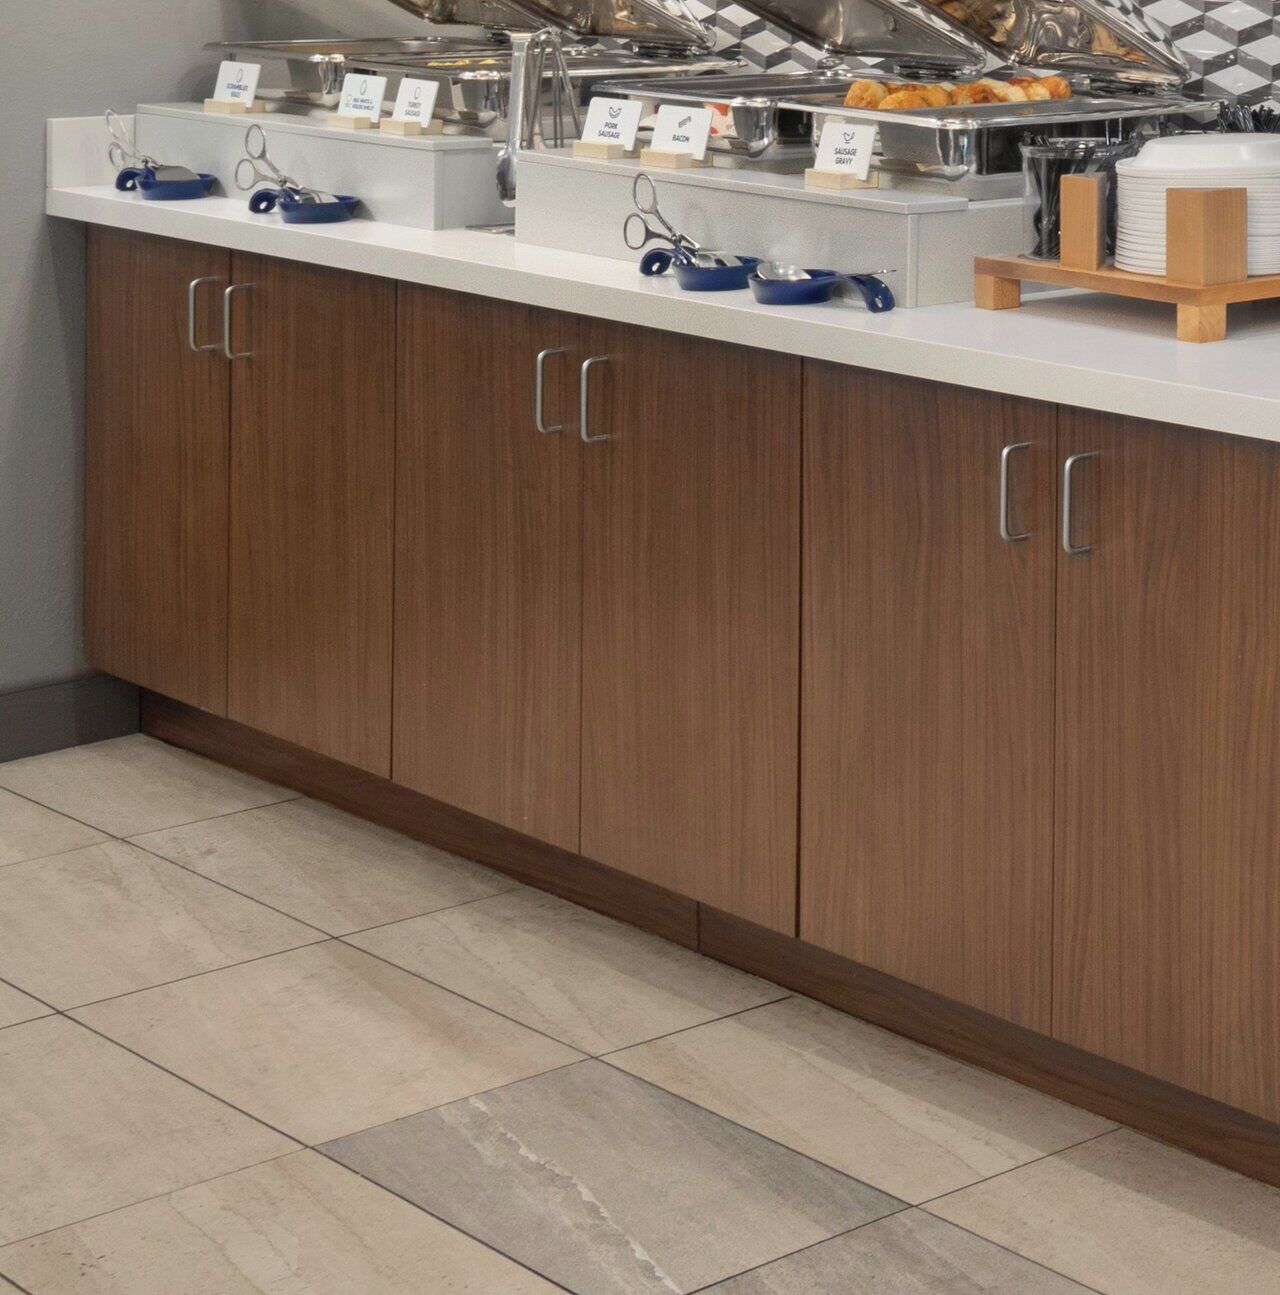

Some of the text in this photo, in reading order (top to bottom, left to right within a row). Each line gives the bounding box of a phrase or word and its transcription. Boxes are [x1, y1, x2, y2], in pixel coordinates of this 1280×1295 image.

[603, 121, 618, 130] PORK
[598, 130, 621, 140] SAUSAGE
[671, 134, 690, 143] BACON
[834, 147, 858, 157] SAUSAGE
[835, 157, 854, 166] GRAVY
